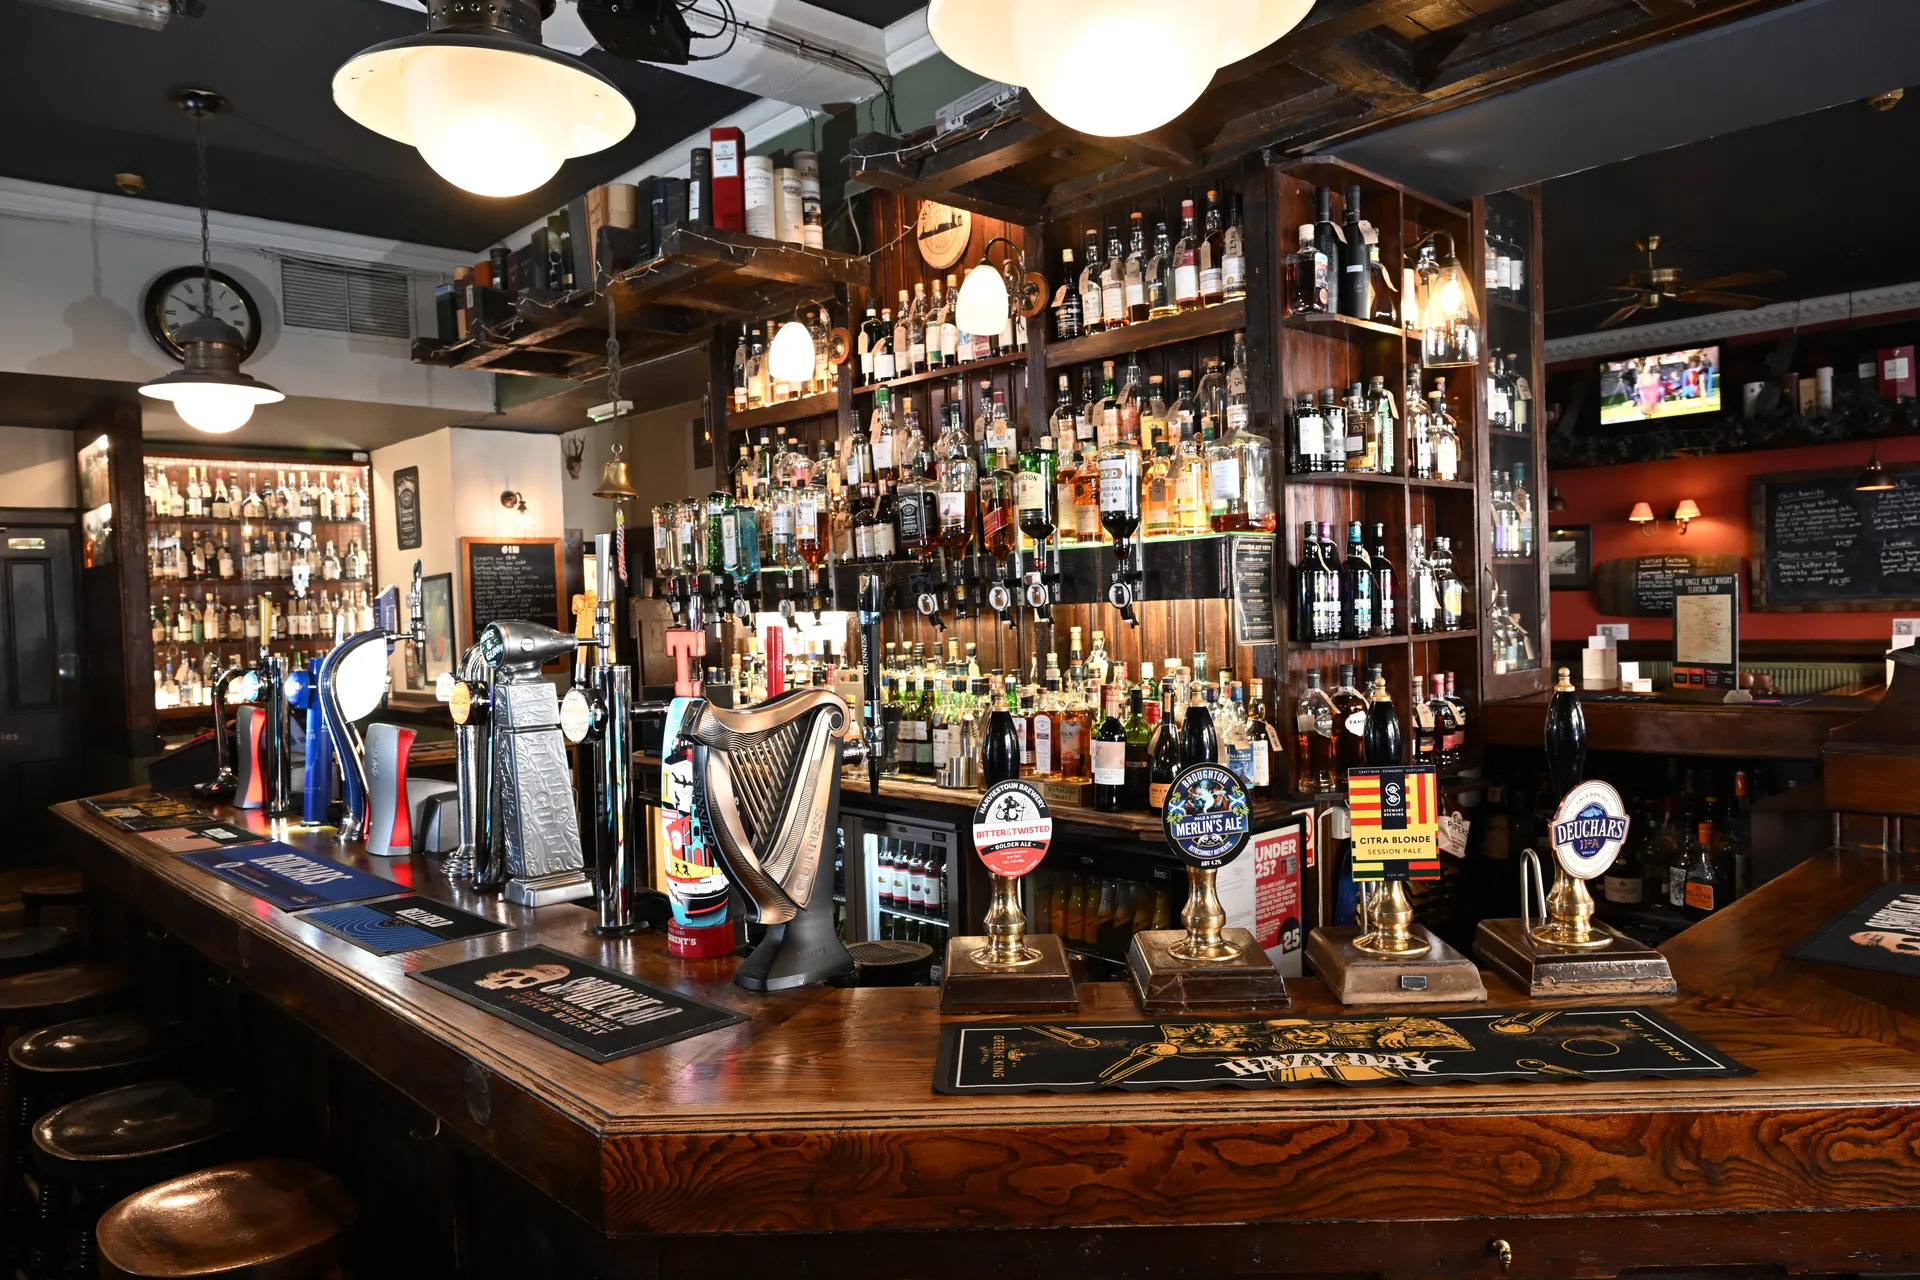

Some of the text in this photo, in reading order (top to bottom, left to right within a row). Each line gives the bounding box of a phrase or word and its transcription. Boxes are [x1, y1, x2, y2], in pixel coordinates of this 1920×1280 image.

[501, 545, 520, 554] GIN
[1685, 578, 1700, 586] SINGLE
[1702, 577, 1713, 585] MALT
[1715, 576, 1732, 584] WHISKY
[1688, 586, 1706, 594] FLAVOUR
[486, 644, 504, 660] GUNN
[1182, 770, 1230, 788] BROUGHTON
[979, 782, 1046, 814] HARVIESTOUN BREWERY
[693, 771, 716, 847] GUINNESS
[976, 825, 1050, 838] BITTER&TWISTED
[1225, 816, 1242, 831] ALE
[1448, 821, 1468, 837] PIPERS
[1557, 818, 1624, 843] DEUCHARS
[994, 842, 1019, 850] GOLDEN
[1360, 836, 1431, 844] CITRA BLONDE
[1580, 838, 1600, 850] IPA
[1256, 838, 1296, 863] UNDER
[249, 853, 353, 886] DEUCHARS
[1256, 859, 1276, 879] 25?
[1687, 890, 1711, 900] GLAYVA
[1284, 928, 1300, 950] 25
[540, 976, 683, 1026] SMOKEHEAD
[545, 1001, 593, 1019] SINGLE
[584, 1017, 623, 1031] MALT
[549, 1012, 609, 1035] WHISKY
[1620, 1018, 1691, 1062] FRUITY IPA
[992, 1036, 1004, 1078] GREENE KING
